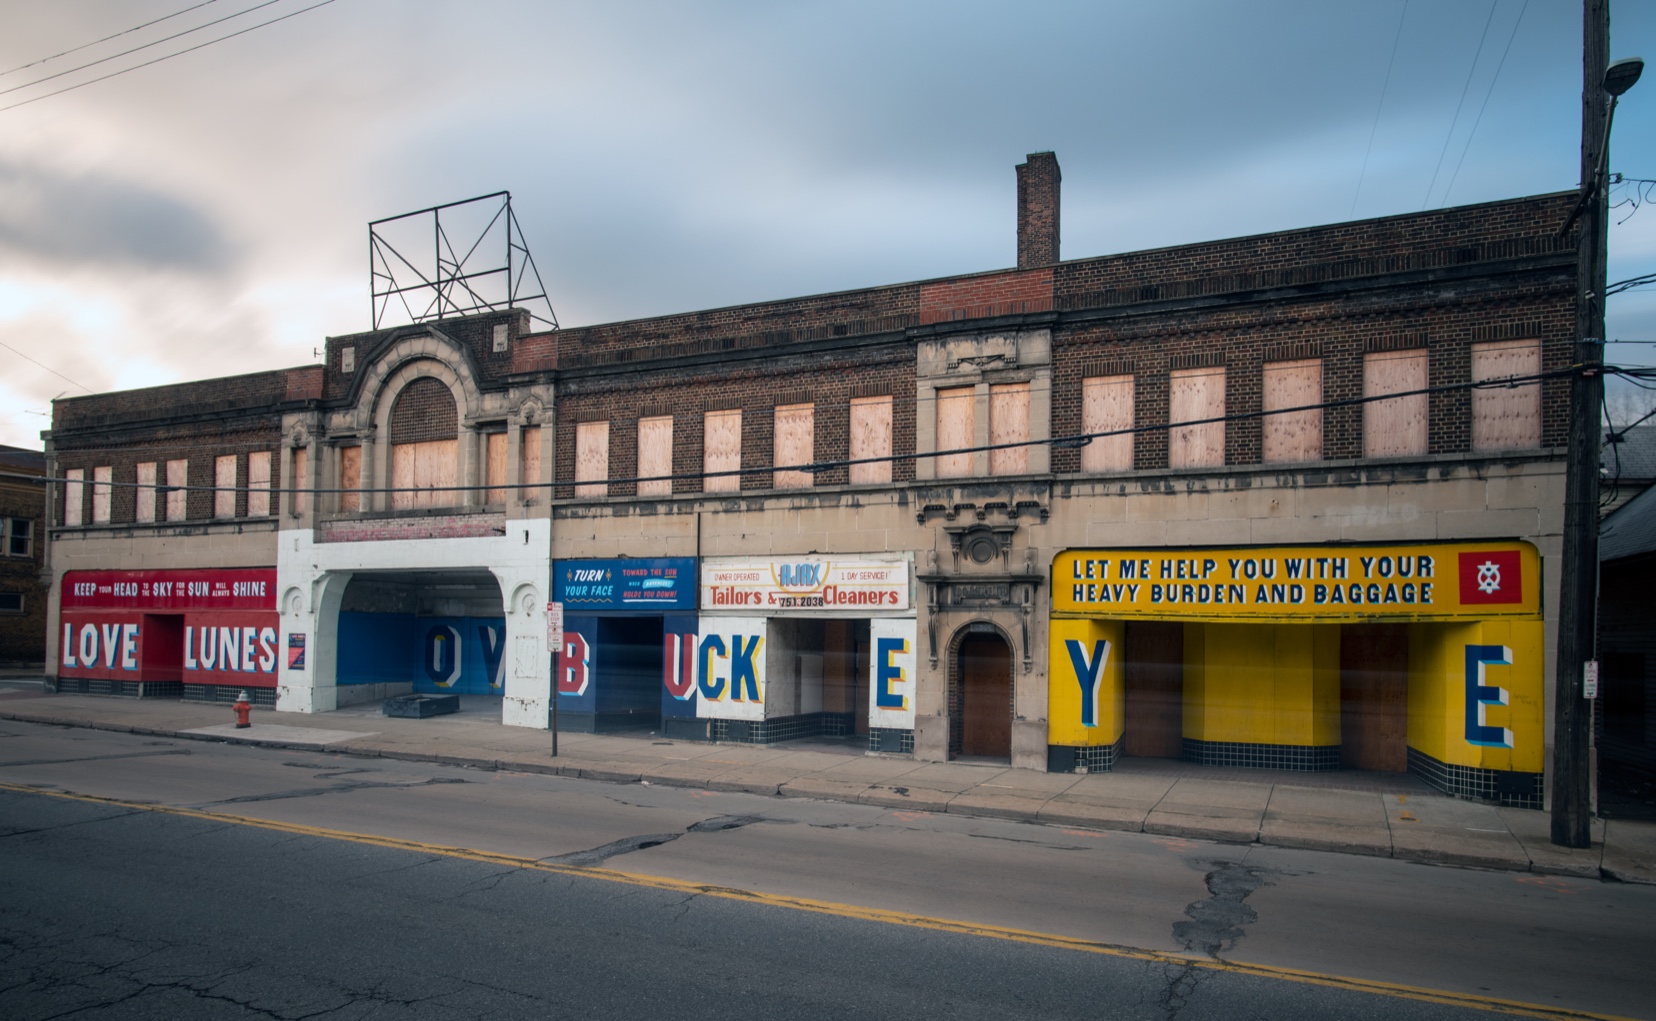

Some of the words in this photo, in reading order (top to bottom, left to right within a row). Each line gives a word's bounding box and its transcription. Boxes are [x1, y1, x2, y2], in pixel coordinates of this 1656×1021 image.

[574, 569, 605, 582] TURN
[622, 569, 648, 577] TOWARD
[650, 568, 662, 576] THE
[664, 568, 677, 576] SUN
[778, 563, 821, 587] AJAX
[1073, 559, 1111, 580] LET
[1119, 559, 1152, 580] ME
[1160, 558, 1218, 580] HELP
[1227, 558, 1277, 580] YOU
[1284, 557, 1349, 580] WITH
[1360, 555, 1435, 579] YOUR
[714, 573, 733, 582] OWNER
[733, 573, 760, 582] OPERATED
[847, 572, 858, 580] DAY
[74, 582, 97, 596] KEEP
[99, 585, 112, 594] YOUR
[113, 582, 138, 597] HEAD
[153, 581, 173, 597] SKY
[188, 581, 210, 597] SUN
[212, 589, 230, 597] ALWAYS
[233, 581, 266, 597] SHINE
[565, 585, 588, 596] YOUR
[591, 585, 613, 596] FACE
[710, 586, 762, 605] Tailors
[767, 592, 777, 605] &
[823, 585, 899, 605] Cleaners
[1072, 583, 1141, 603] HEAVY
[1151, 583, 1247, 604] BURDEN
[1255, 583, 1306, 605] AND
[1313, 582, 1434, 605] BAGGAGE
[63, 622, 140, 671] LOVE
[184, 626, 278, 673] LUNES
